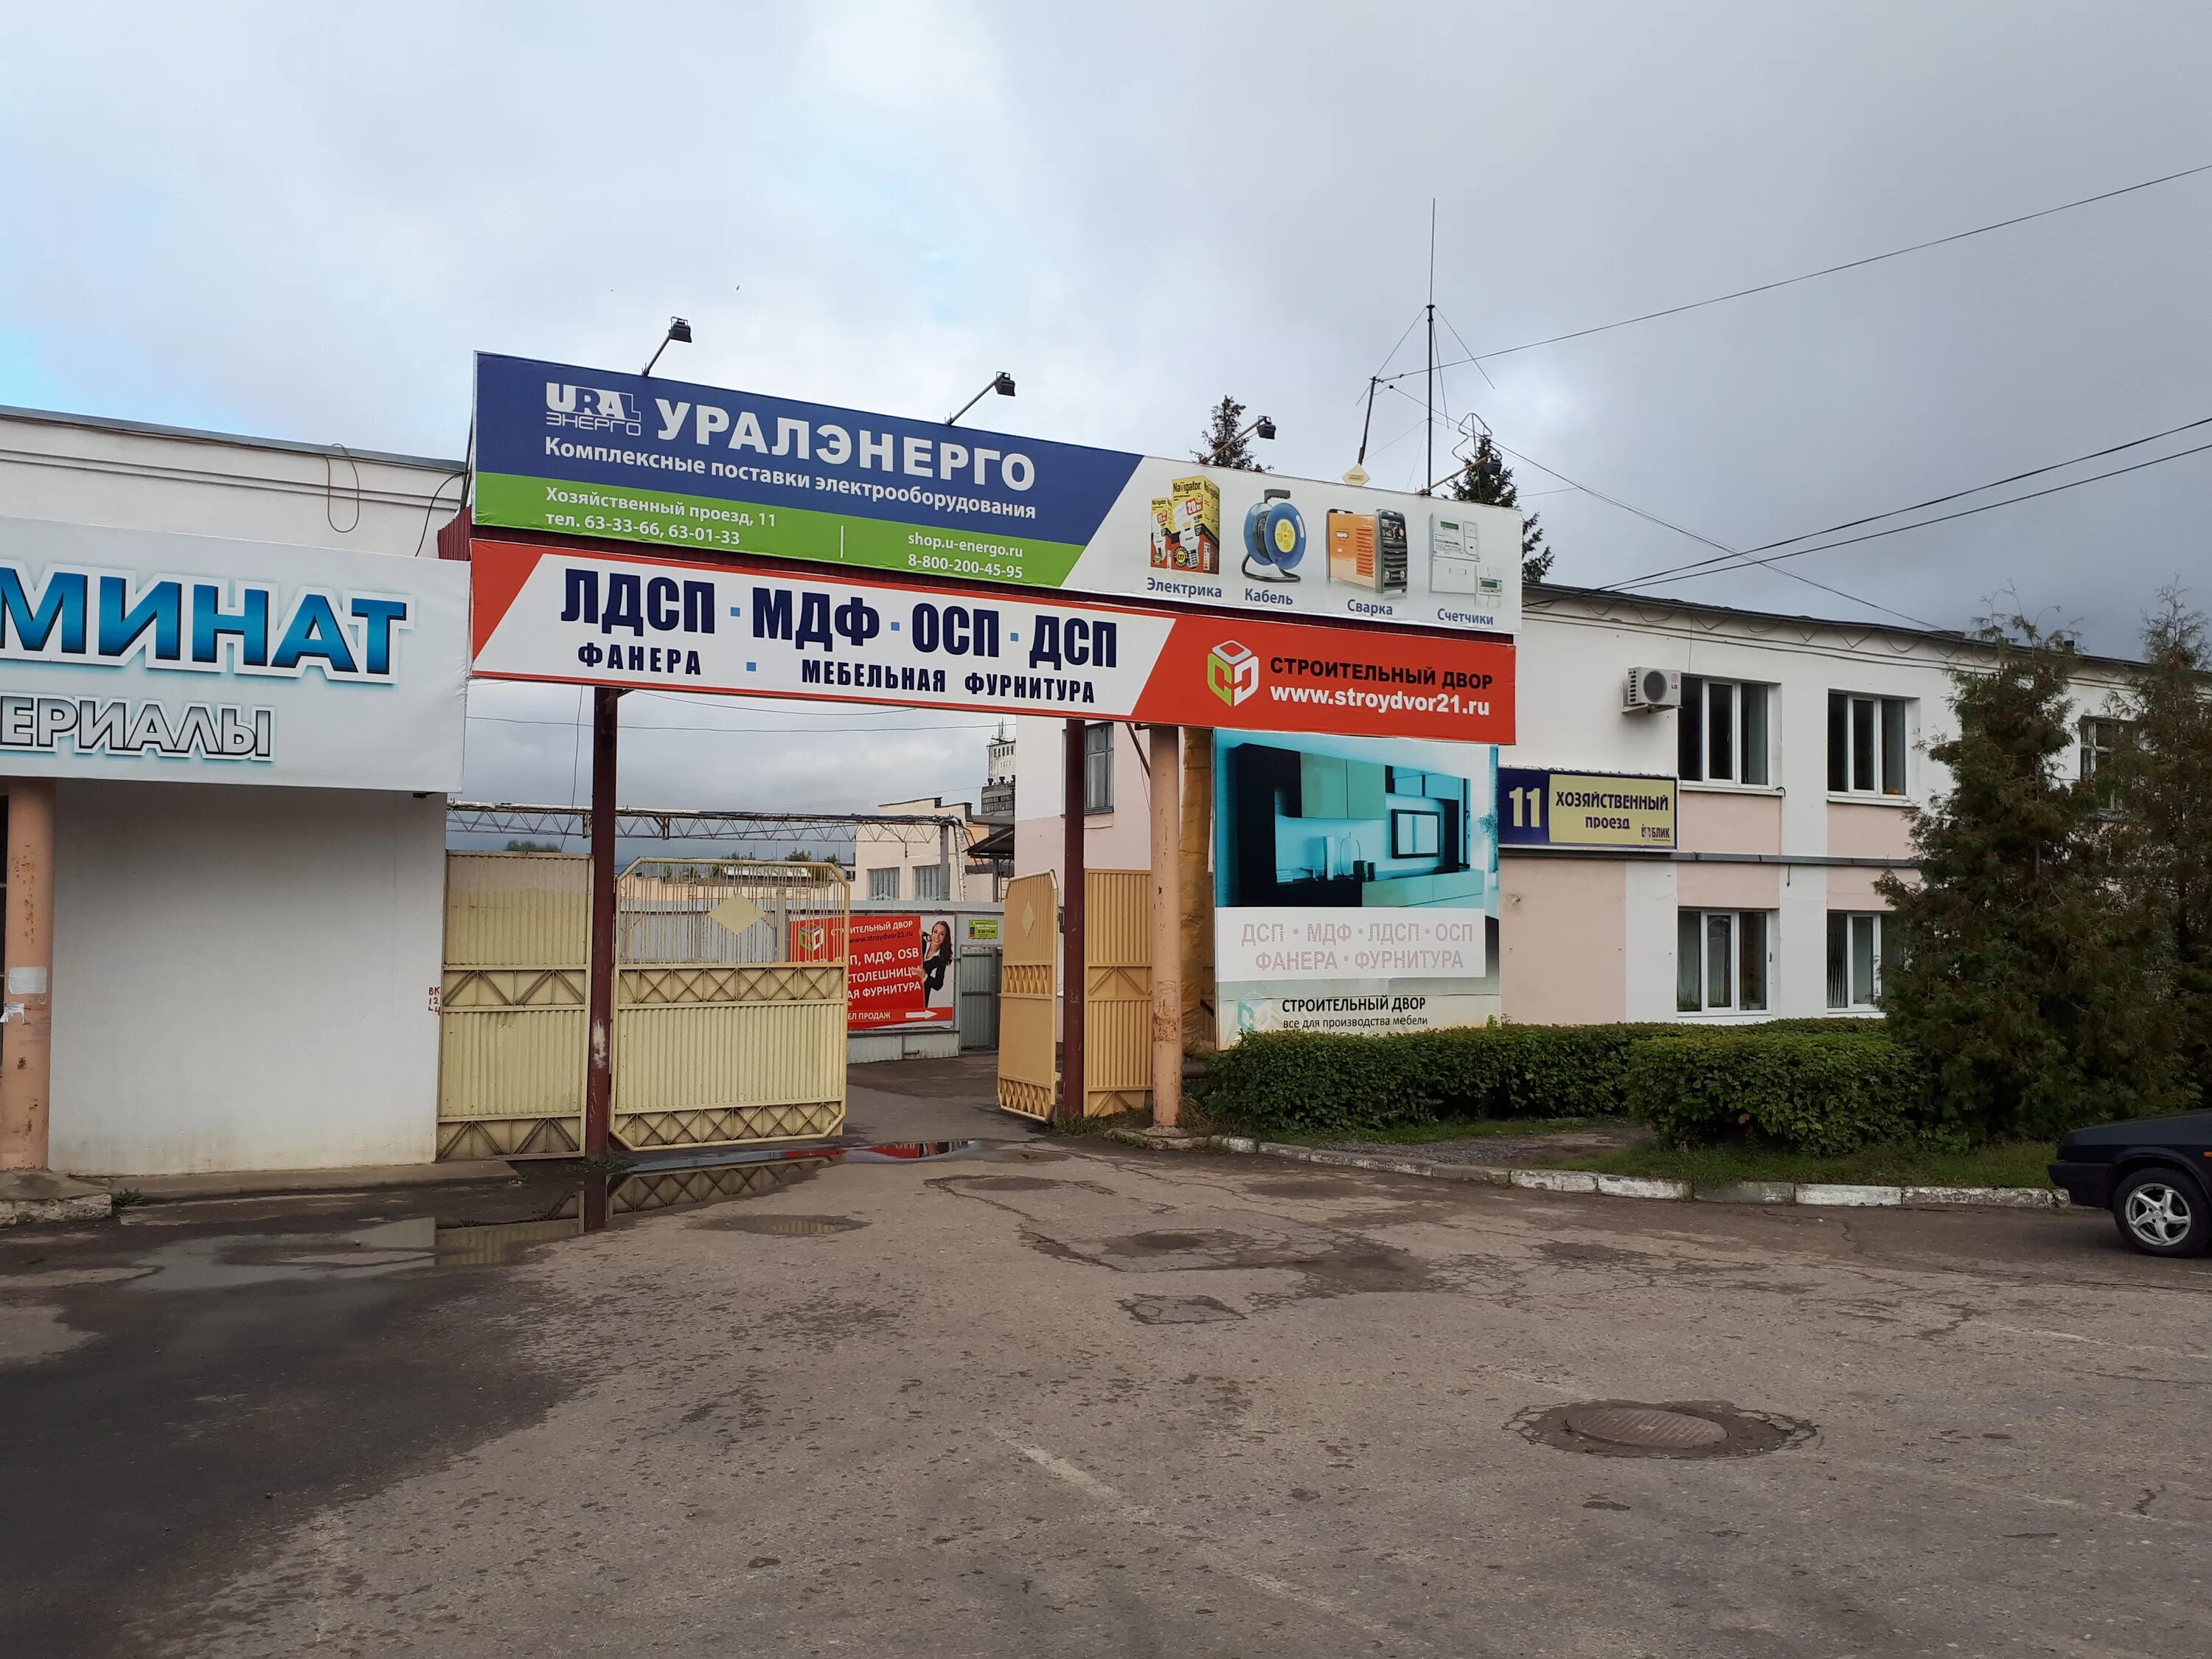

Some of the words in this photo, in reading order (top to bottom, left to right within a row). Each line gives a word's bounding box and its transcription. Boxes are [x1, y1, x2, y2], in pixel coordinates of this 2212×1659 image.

[546, 411, 641, 437] ЭНЕРГО
[655, 397, 1036, 492] УРАЛЭНЕРГО
[545, 437, 706, 476] Комплексные
[711, 462, 810, 490] поставки
[815, 476, 1036, 519] электрооборудования
[1173, 481, 1202, 493] Navigator
[546, 486, 686, 516] Хозяйственный
[689, 507, 754, 527] проезд,
[758, 512, 776, 527] 11
[546, 513, 581, 529] тел.
[584, 515, 665, 539] 63-33-66,
[668, 524, 741, 546] 63-01-33
[907, 532, 1023, 558] shop.u-energo.ru
[907, 553, 1023, 579] 8-800-200-45-95
[1146, 577, 1222, 599] Электрика
[1244, 588, 1293, 606] Кабель
[1346, 599, 1393, 616] Сварка
[1436, 608, 1494, 625] Счетчики
[0, 566, 407, 675] МИНАТ
[560, 568, 716, 637] ЛДСП
[752, 586, 880, 653] МДФ
[911, 602, 1000, 658] ОСП
[1029, 614, 1117, 671] ДСП
[577, 642, 702, 675] ФАНЕРА
[801, 658, 946, 693] МЕБЕЛЬНАЯ
[964, 672, 1095, 704] ФУРНИТУРА
[1270, 656, 1436, 686] СТРОИТЕЛЬНЫЙ
[1441, 670, 1493, 691] ДВОР
[1270, 684, 1490, 715] www.stroydvor21.ru
[0, 696, 271, 757] ЕРИАЛЫ
[1509, 787, 1540, 827] 11
[1556, 791, 1669, 811] ХОЗЯЙСТВЕННЫЙ
[1585, 816, 1630, 830] проезд
[1652, 827, 1670, 838] БЛИК
[831, 921, 891, 936] СТРИТЕЛЬНЫЙ
[893, 920, 914, 931] ДВОР
[1240, 923, 1284, 946] ДСП
[1307, 922, 1352, 945] МДФ
[1367, 922, 1419, 945] ЛДСП
[1435, 923, 1472, 942] ОСП
[864, 950, 895, 964] МДФ,
[897, 947, 919, 959] OSB
[1255, 951, 1338, 971] ФАНЕРА
[1354, 950, 1464, 969] ФУРНИТУРА
[863, 981, 921, 998] ФУРНИТУРА
[1281, 995, 1389, 1012] СТРОИТЕЛЬНЫЙ
[1391, 996, 1426, 1013] ДВОР
[858, 1012, 891, 1020] ПРОДАЖ
[1283, 1019, 1300, 1029] все
[1301, 1018, 1320, 1031] для
[1322, 1017, 1390, 1029] производства
[1392, 1014, 1427, 1026] мебели
